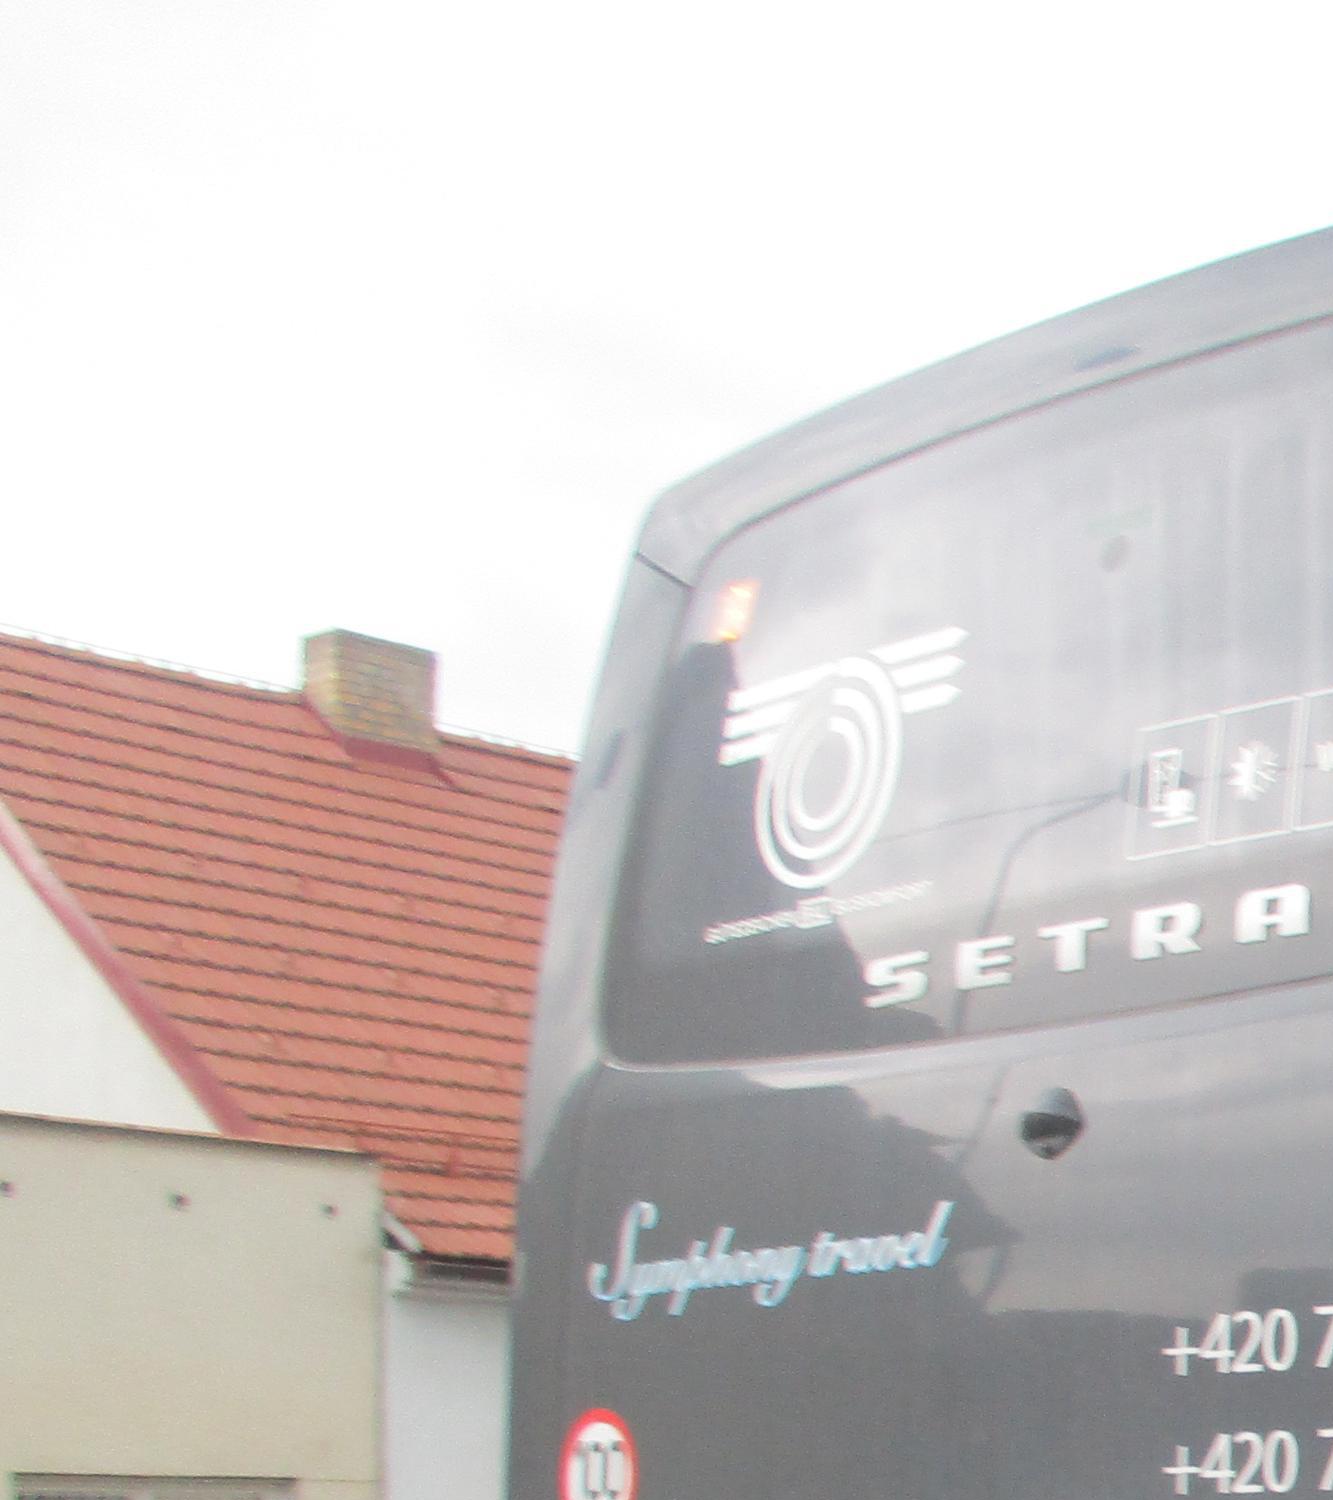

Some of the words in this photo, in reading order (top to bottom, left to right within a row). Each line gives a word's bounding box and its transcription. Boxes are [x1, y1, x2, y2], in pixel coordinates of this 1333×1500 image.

[863, 882, 1312, 1009] SETRA
[588, 1200, 801, 1322] Symphony
[808, 1200, 956, 1278] travel
[1160, 1307, 1300, 1377] +420
[1160, 1429, 1300, 1496] +420
